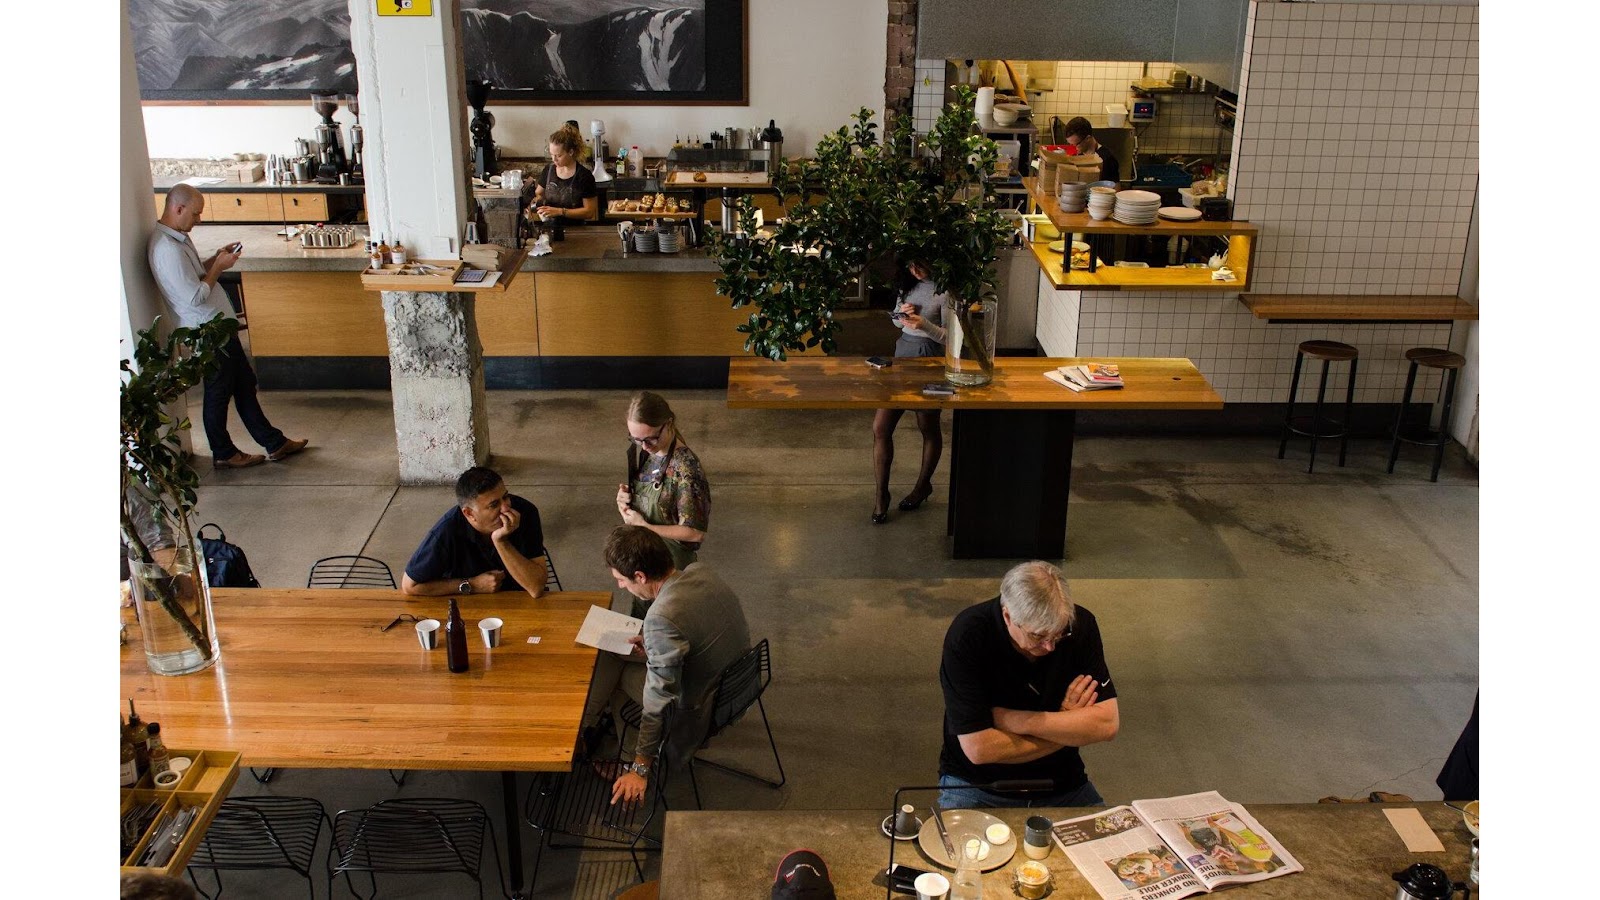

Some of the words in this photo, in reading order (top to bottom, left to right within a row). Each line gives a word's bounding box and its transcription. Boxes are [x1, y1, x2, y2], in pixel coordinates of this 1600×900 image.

[1199, 864, 1214, 873] THE
[1204, 870, 1231, 880] DIVIDE
[1137, 885, 1160, 895] HOLE
[1141, 885, 1182, 900] BONKERS
